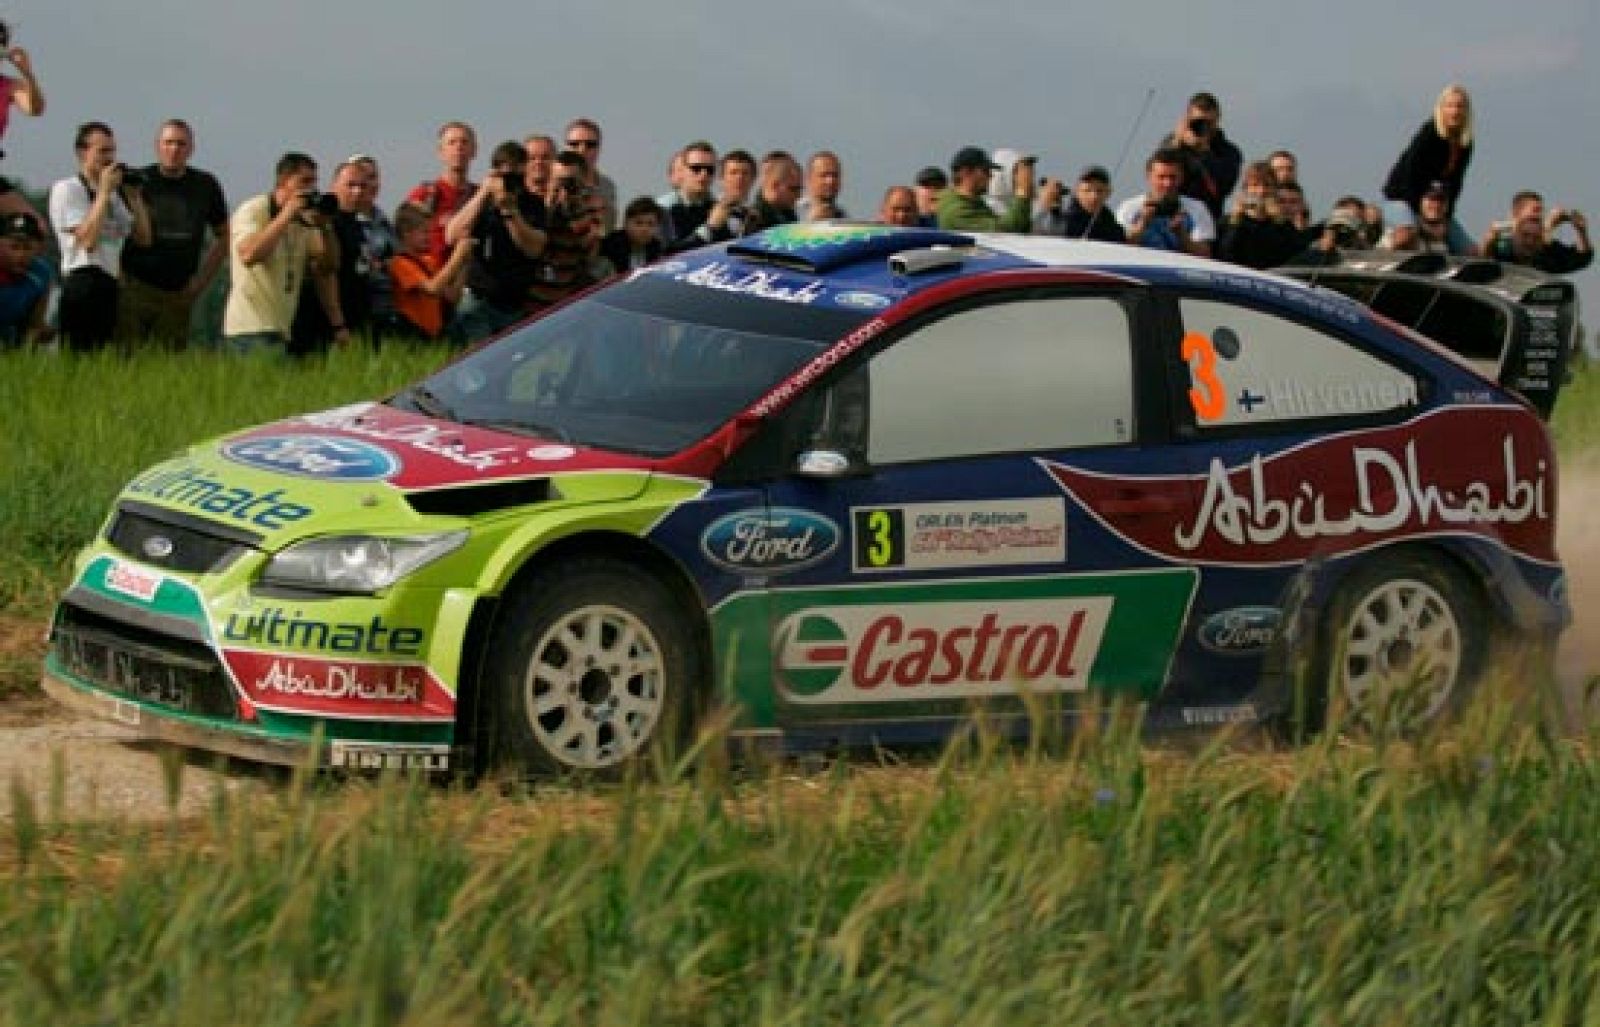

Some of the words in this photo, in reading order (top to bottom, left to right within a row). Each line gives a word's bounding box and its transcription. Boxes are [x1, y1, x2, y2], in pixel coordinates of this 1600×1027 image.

[1180, 331, 1226, 421] 3
[726, 517, 815, 563] Ford
[868, 511, 892, 567] 3
[851, 608, 1088, 690] Castrol
